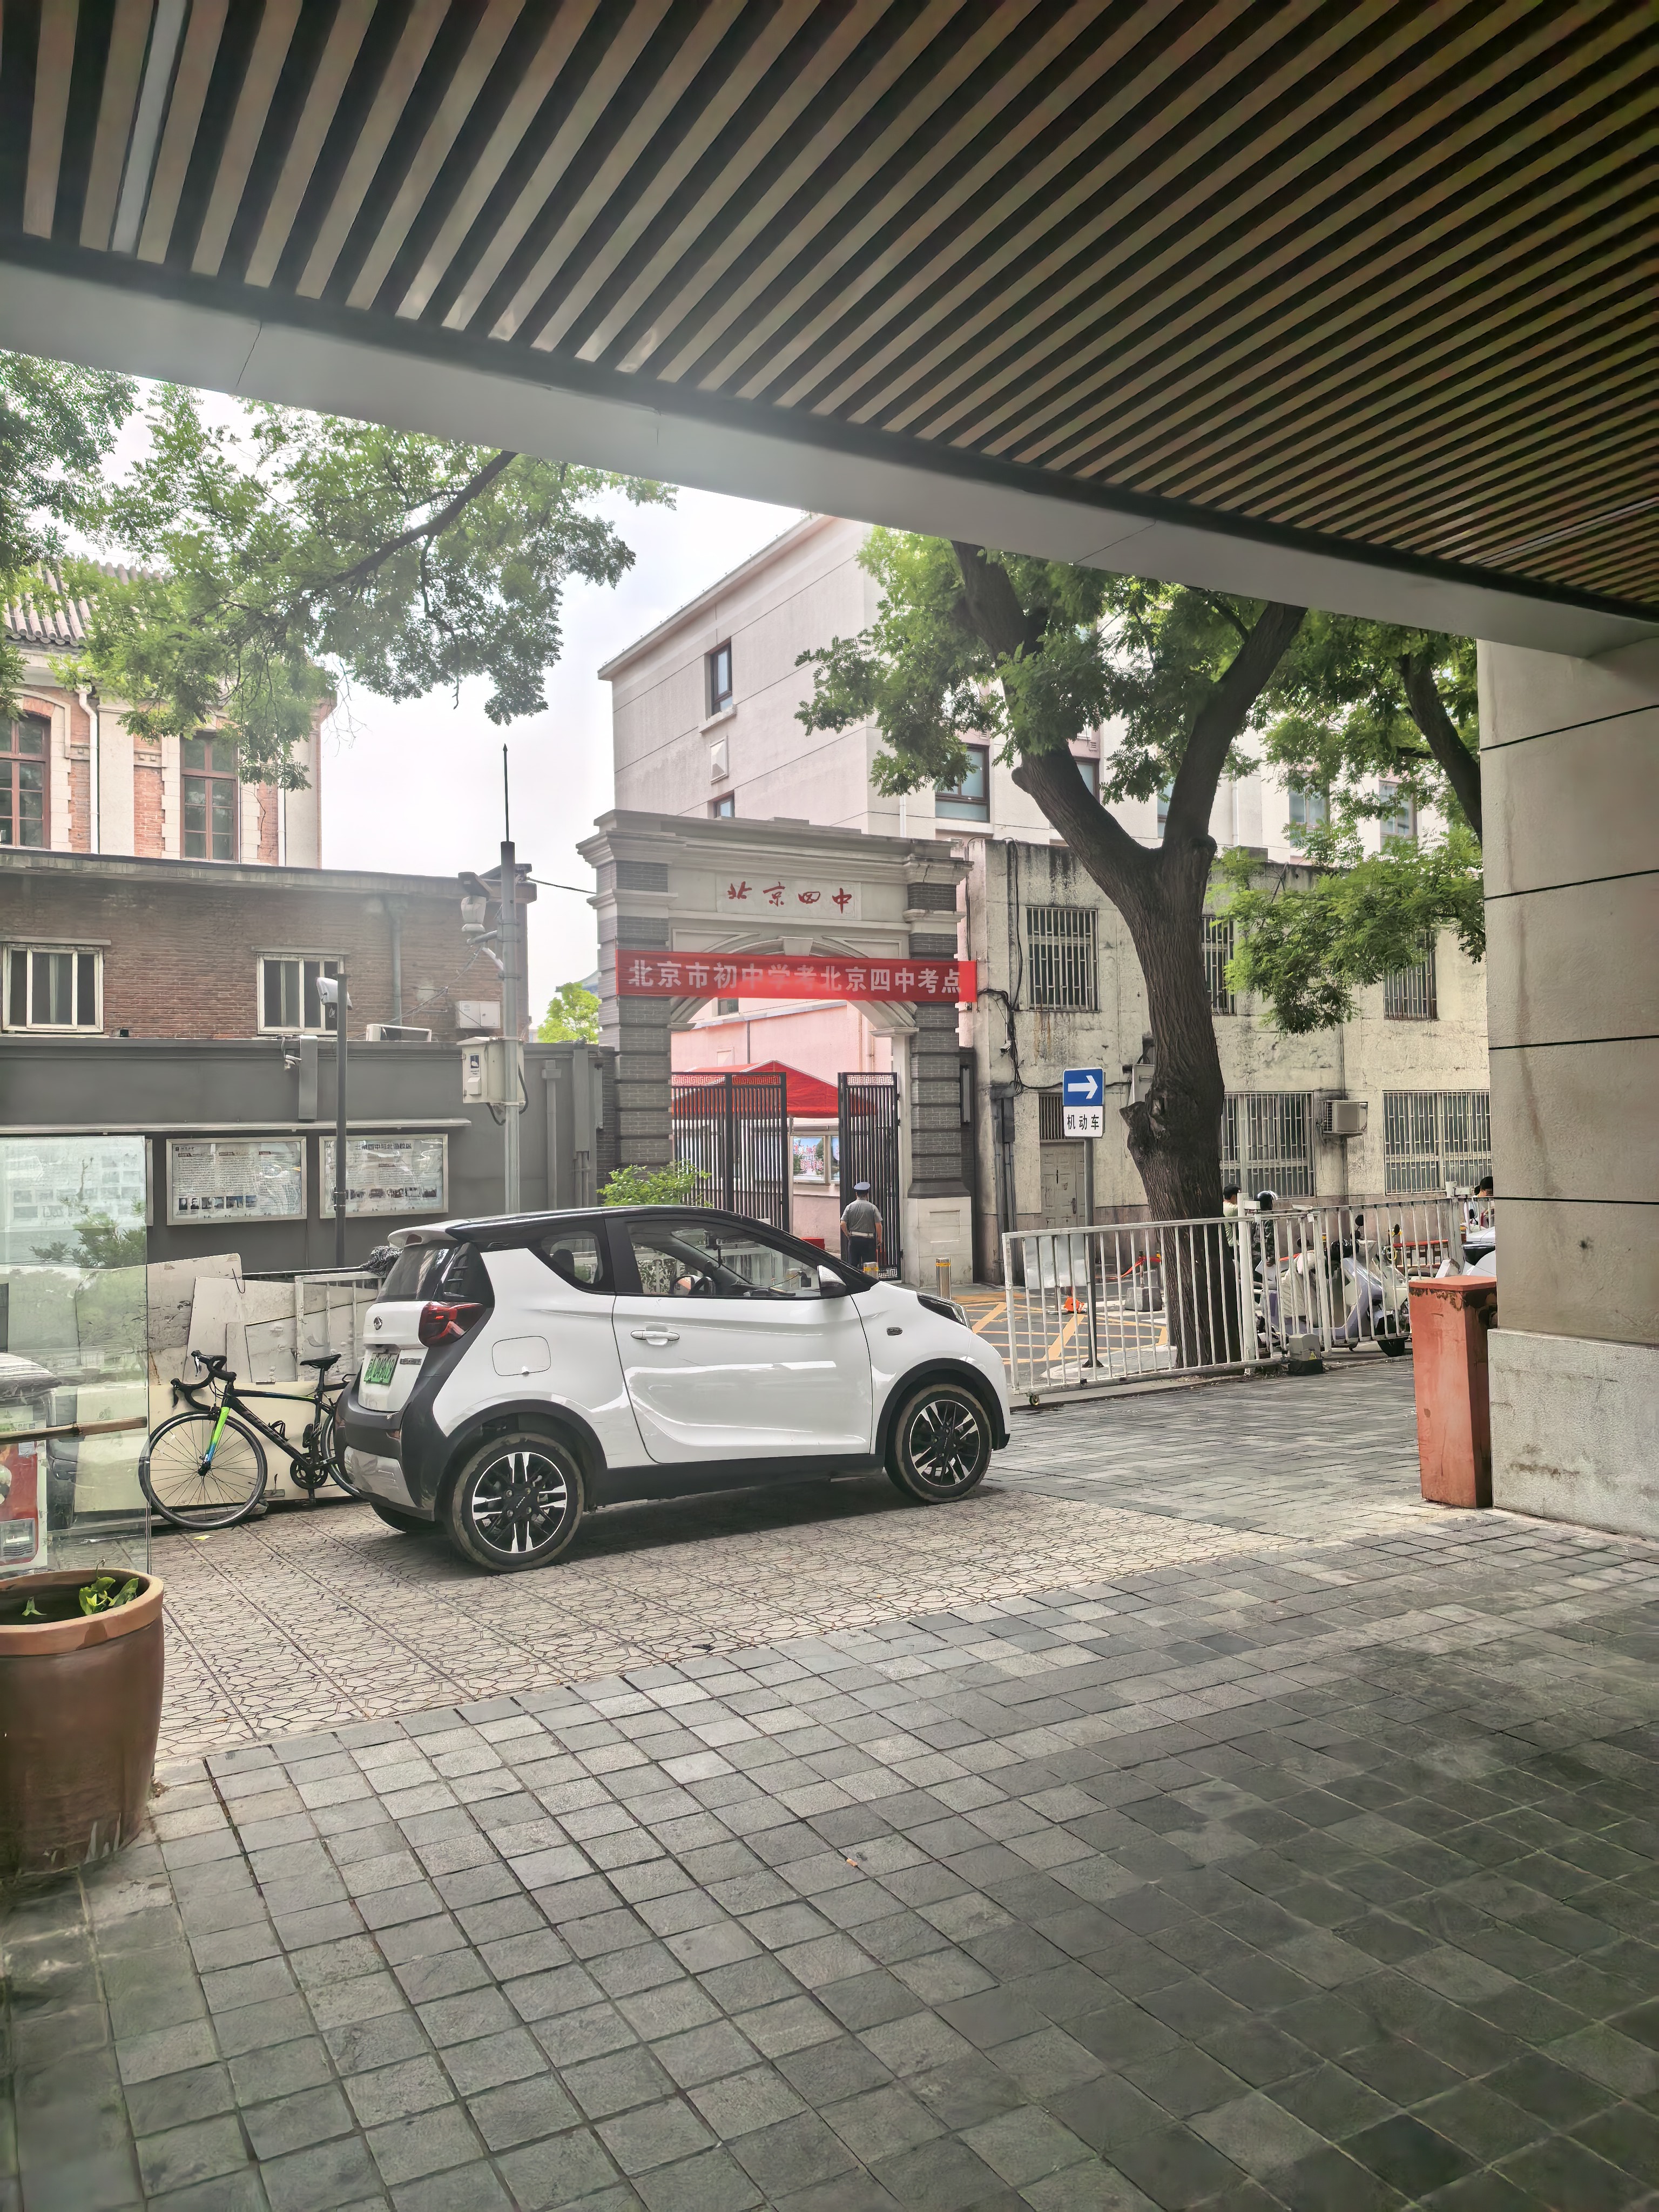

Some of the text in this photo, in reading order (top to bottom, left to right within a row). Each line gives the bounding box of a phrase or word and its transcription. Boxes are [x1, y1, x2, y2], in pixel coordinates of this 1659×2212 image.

[727, 881, 852, 914] 北京四中
[628, 960, 961, 994] 北京市初中学考北京四中考点
[1067, 1114, 1099, 1130] 机动车
